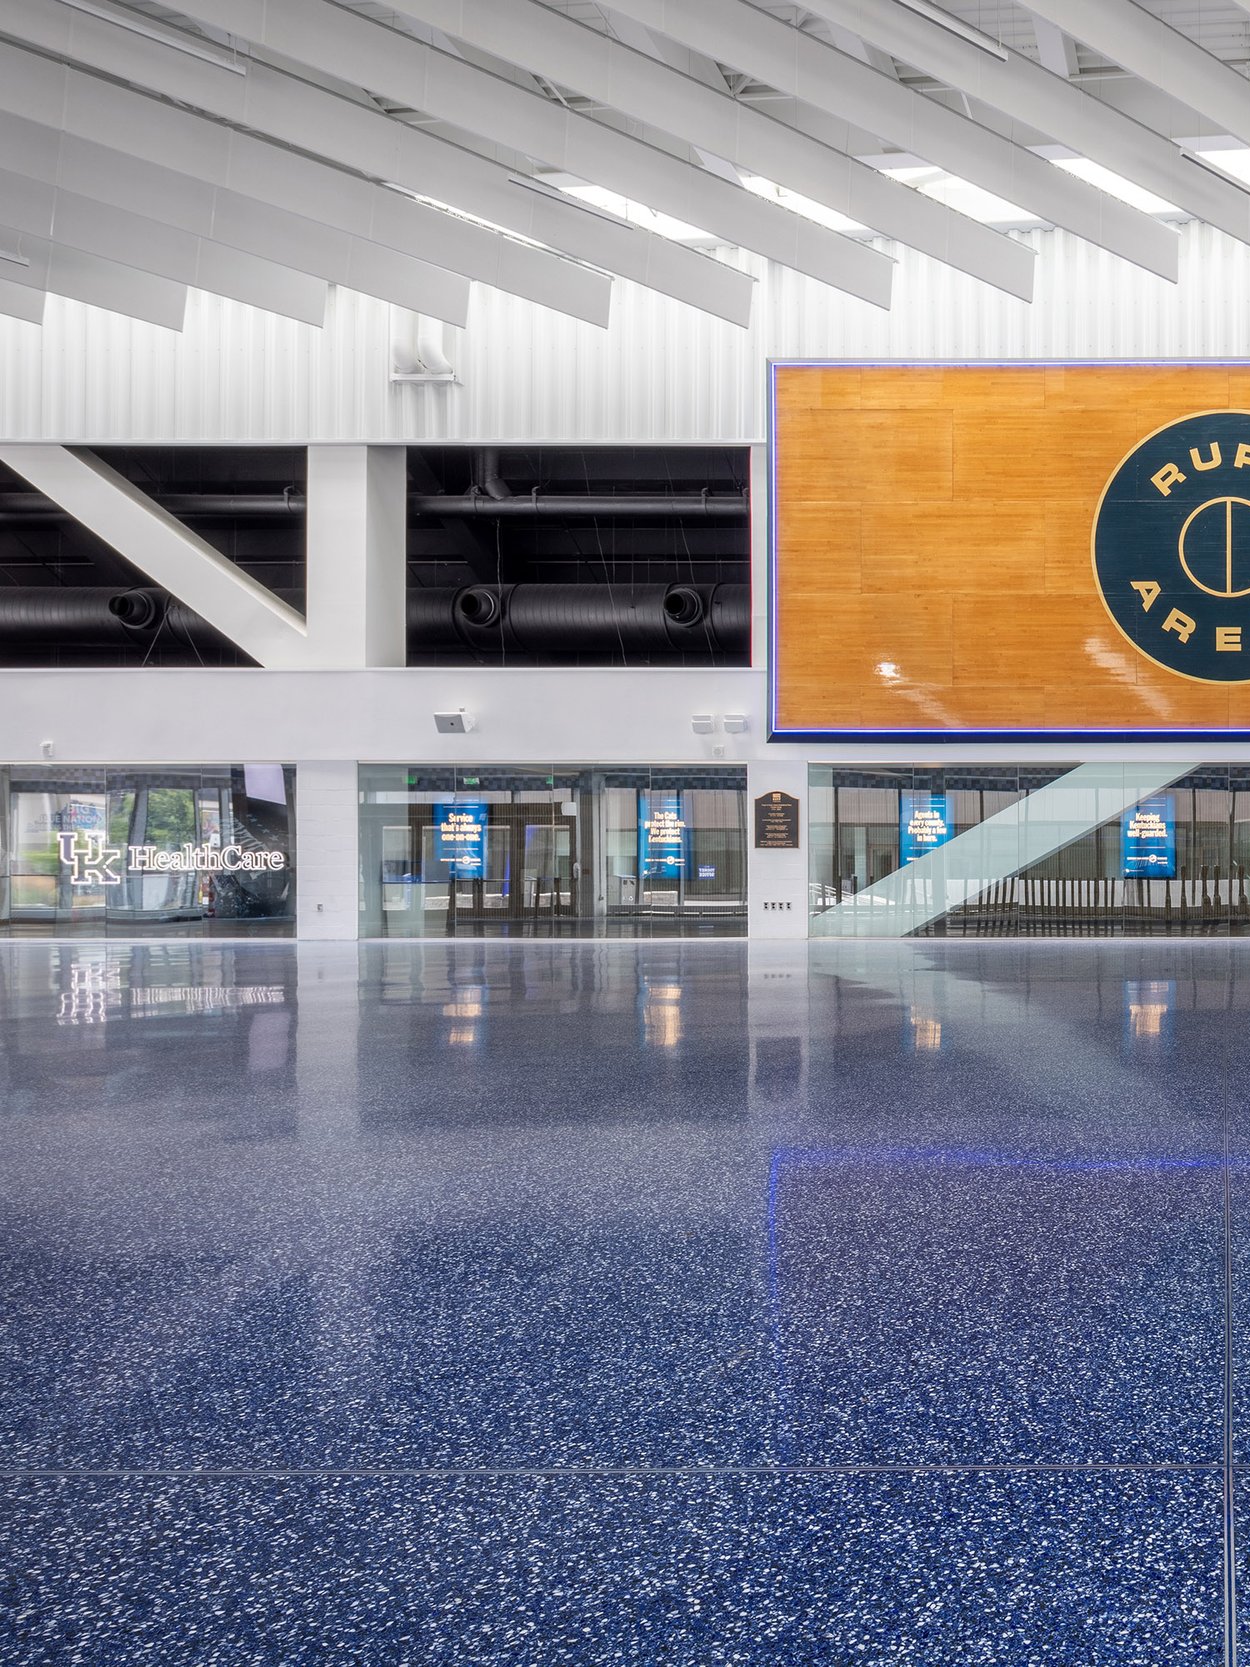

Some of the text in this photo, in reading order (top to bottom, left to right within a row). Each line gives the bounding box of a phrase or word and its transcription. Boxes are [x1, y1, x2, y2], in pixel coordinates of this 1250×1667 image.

[1135, 812, 1160, 822] Keeping
[1129, 820, 1166, 829] Kentuckians
[57, 832, 285, 884] UK HealthCare
